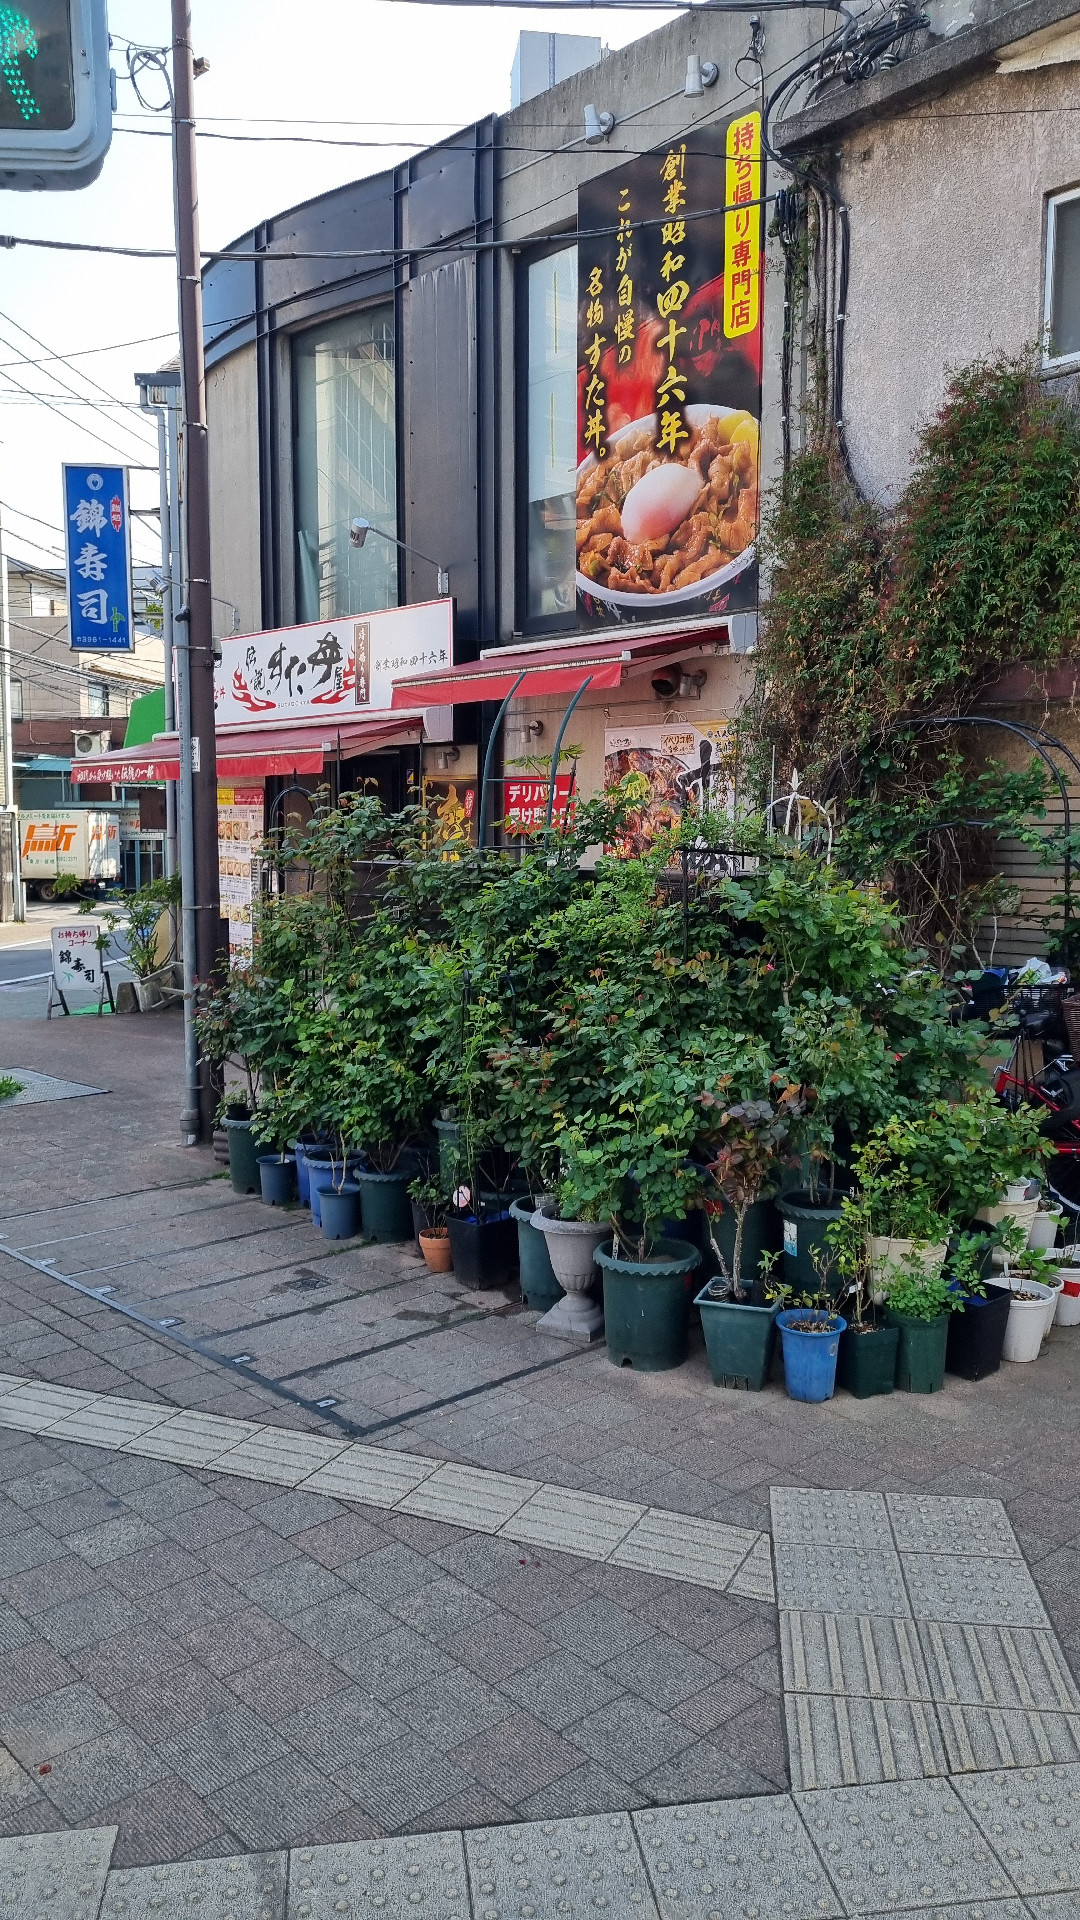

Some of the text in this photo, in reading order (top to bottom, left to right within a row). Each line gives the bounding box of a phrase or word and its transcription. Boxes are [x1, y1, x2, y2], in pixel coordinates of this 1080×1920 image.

[613, 188, 636, 365] これが自慢の
[656, 143, 691, 454] 創業昭和四十六年
[730, 121, 755, 330] 持ち帰り専門店
[584, 266, 608, 458] 名物すた丼。
[70, 499, 109, 625] 錦寿司
[373, 648, 449, 673] 創業昭和四十六年
[59, 949, 95, 983] 錦寿司
